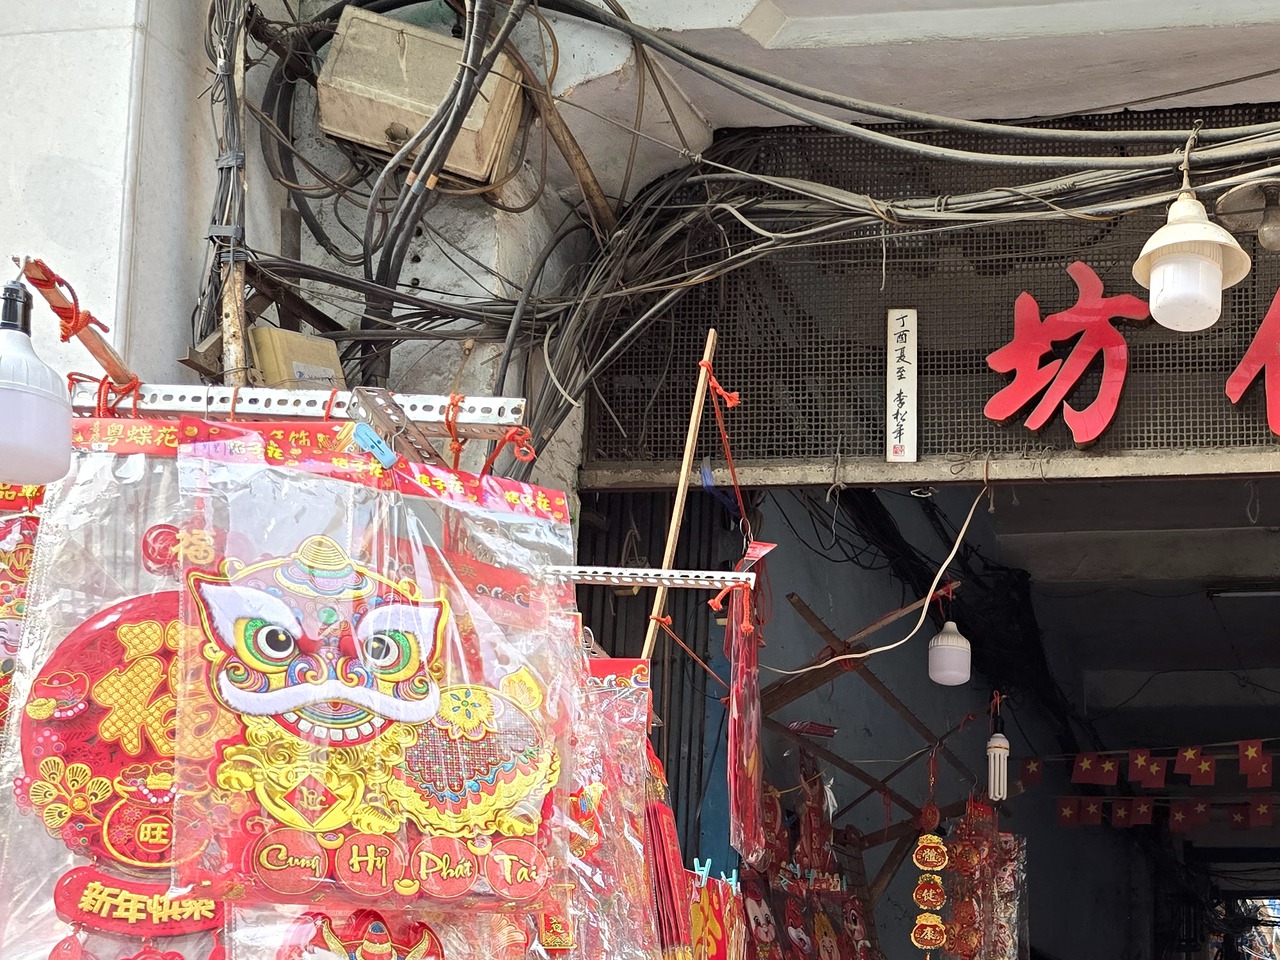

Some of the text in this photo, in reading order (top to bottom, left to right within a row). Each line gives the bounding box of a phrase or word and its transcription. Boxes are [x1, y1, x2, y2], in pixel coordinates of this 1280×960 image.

[893, 314, 912, 381] 丁酉夏至
[92, 619, 241, 758] 福
[139, 822, 171, 845] 旺
[259, 843, 322, 878] Cung
[416, 851, 474, 881] Phát
[494, 853, 540, 884] Tài
